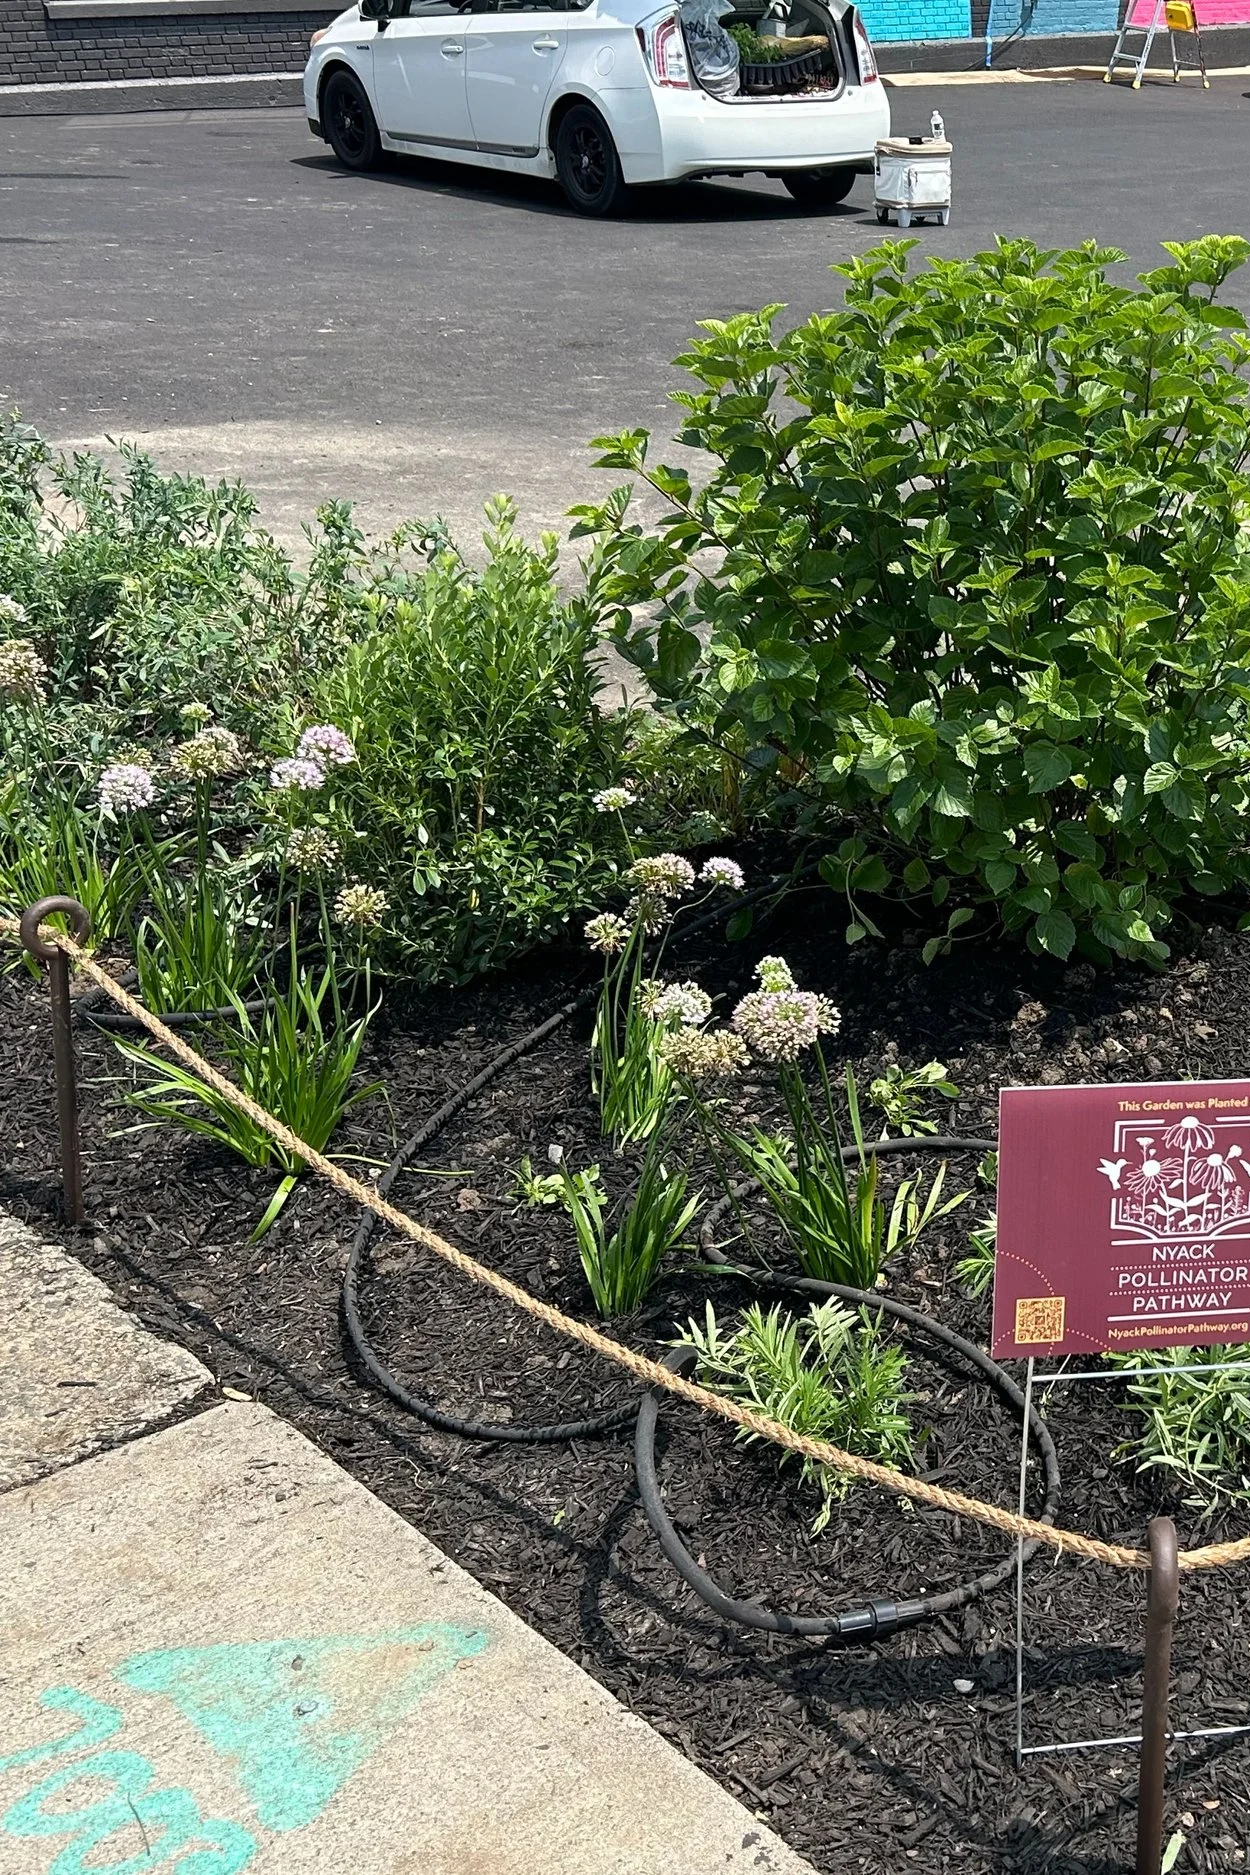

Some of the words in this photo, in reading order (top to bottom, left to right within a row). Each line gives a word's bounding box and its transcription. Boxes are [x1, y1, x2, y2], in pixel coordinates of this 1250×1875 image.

[1118, 1100, 1141, 1111] This
[1142, 1099, 1183, 1111] Garden
[1185, 1100, 1206, 1110] was
[1207, 1096, 1248, 1109] Planted
[1152, 1243, 1216, 1262] NYACK
[1118, 1266, 1248, 1289] POLLINATOR
[1133, 1291, 1232, 1312] PATHWAY
[1108, 1321, 1249, 1341] NyackPollinatorPathway.org
